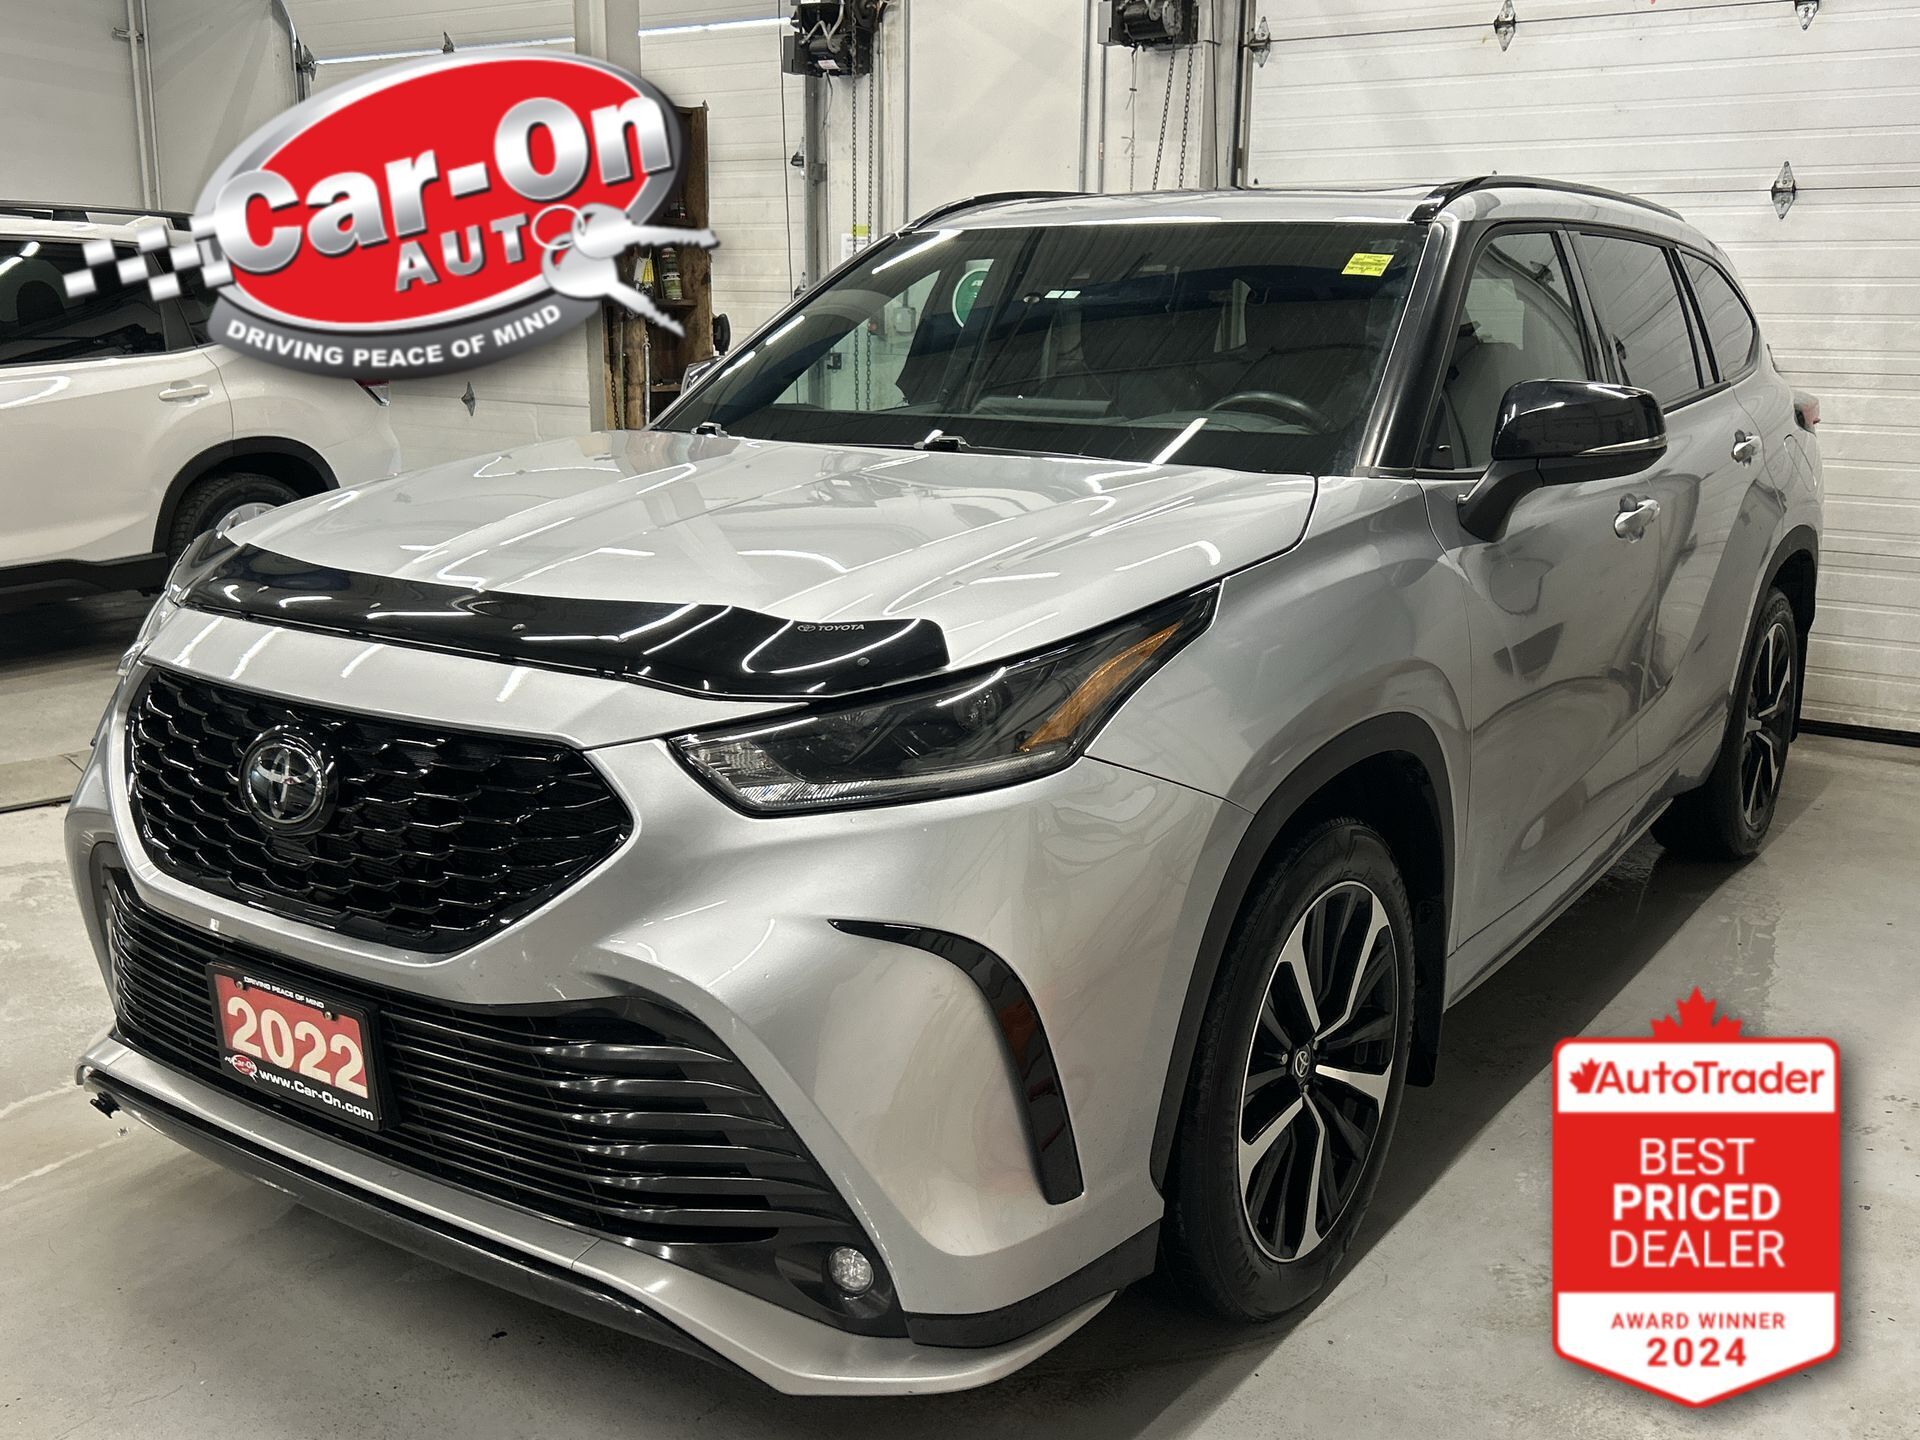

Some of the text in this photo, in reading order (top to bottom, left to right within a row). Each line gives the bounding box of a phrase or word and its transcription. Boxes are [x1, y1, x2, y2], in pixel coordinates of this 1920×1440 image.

[243, 976, 325, 1009] DRIVING PEACE OF MIND
[227, 997, 369, 1099] 2022
[258, 1069, 375, 1122] www.Car-On.com
